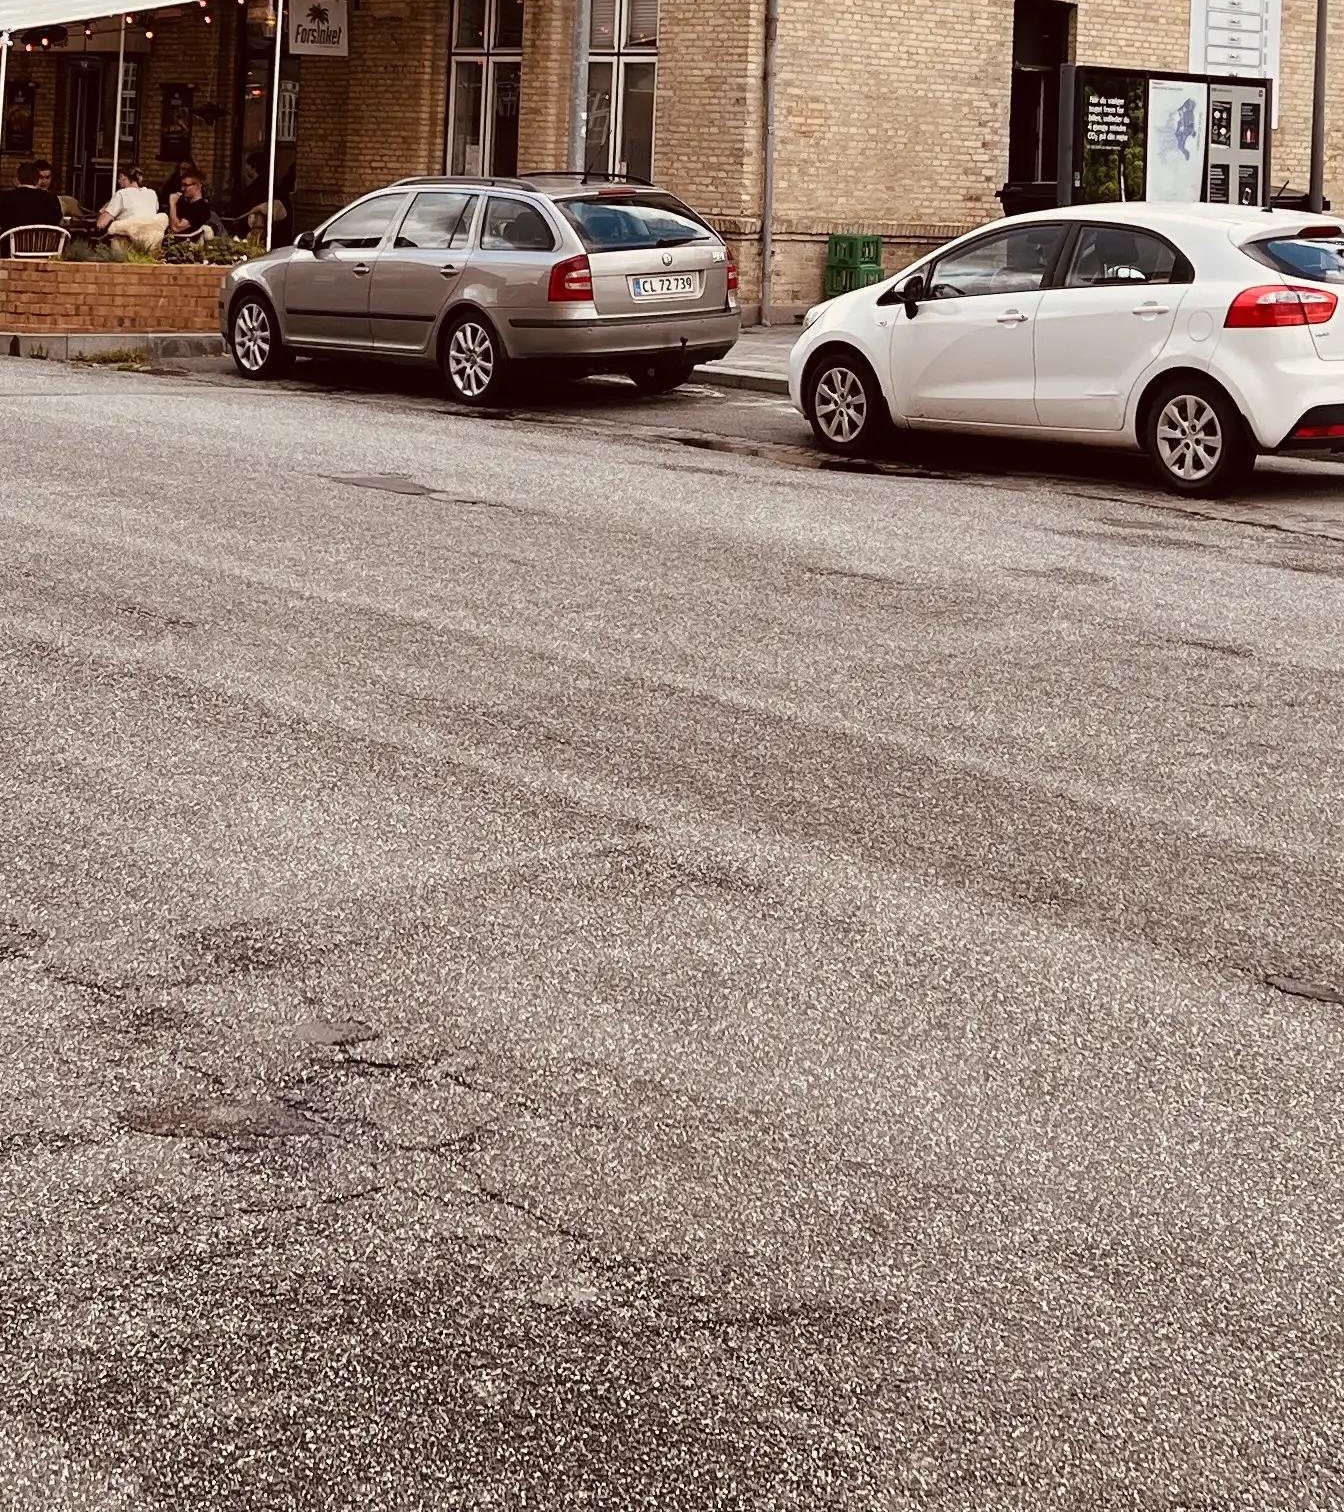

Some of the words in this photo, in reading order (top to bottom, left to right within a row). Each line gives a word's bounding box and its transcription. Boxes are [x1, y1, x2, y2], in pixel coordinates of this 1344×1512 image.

[643, 280, 657, 292] CL
[659, 279, 672, 291] 72
[674, 277, 691, 290] 739
